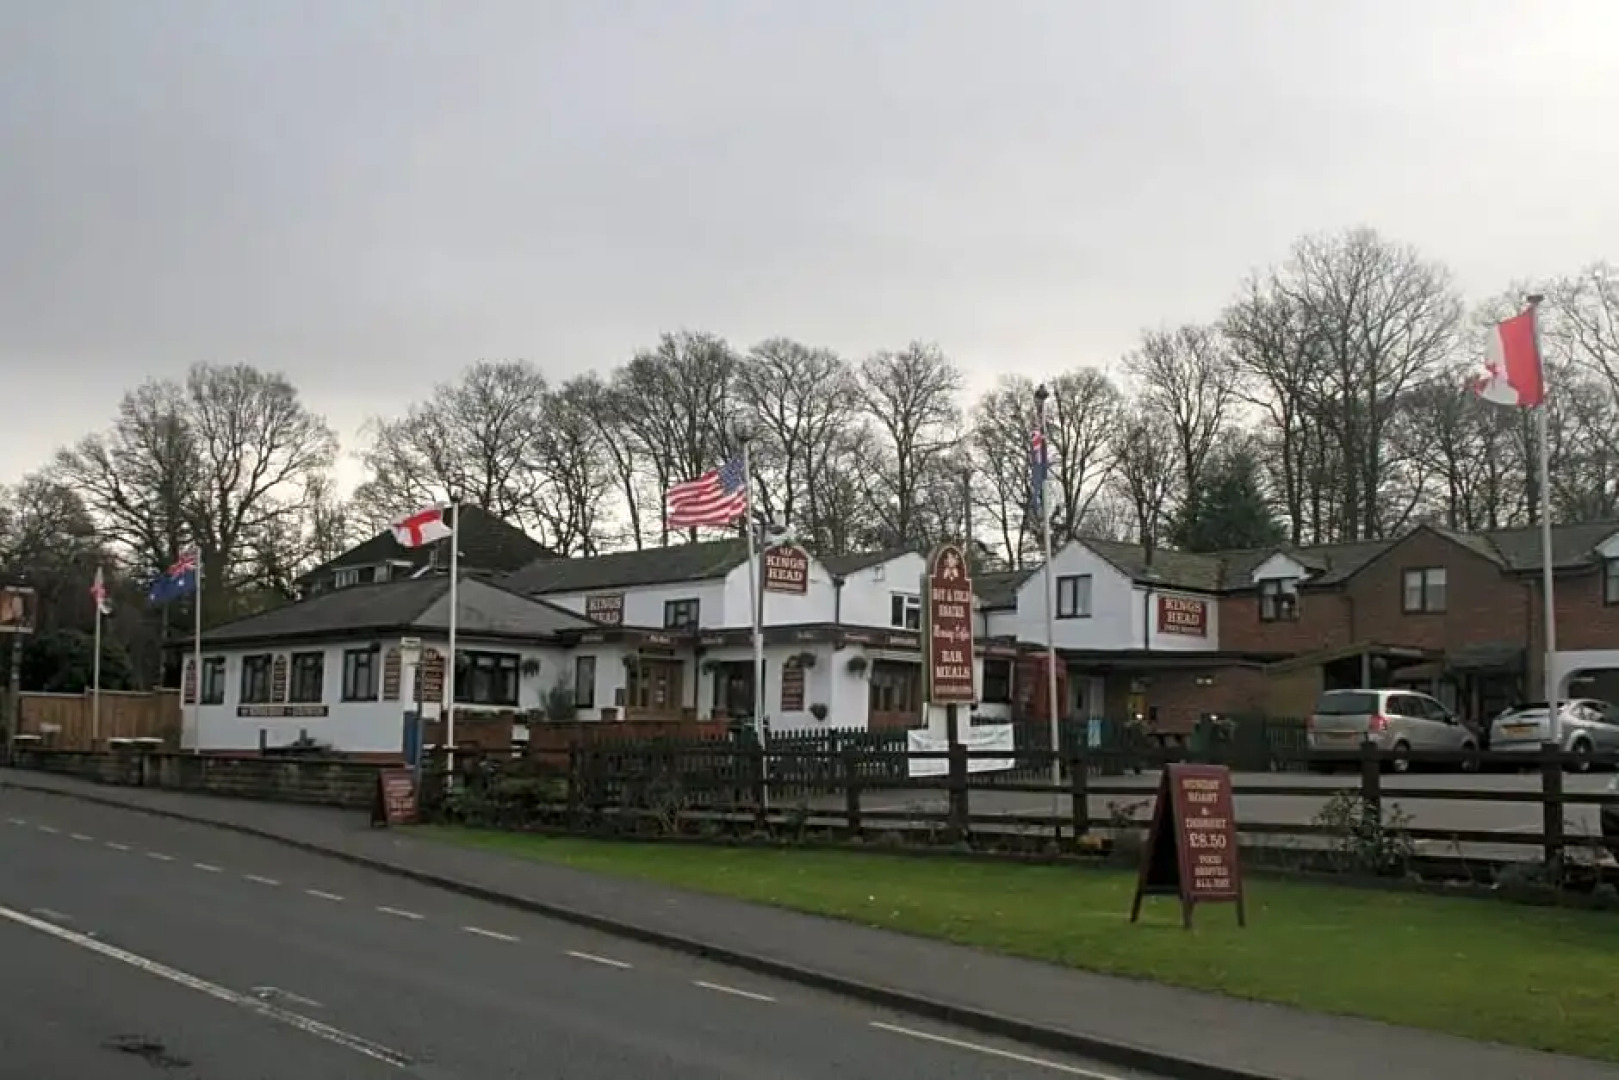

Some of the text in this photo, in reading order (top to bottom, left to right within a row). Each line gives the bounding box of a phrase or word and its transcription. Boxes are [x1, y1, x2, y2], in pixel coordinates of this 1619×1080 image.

[766, 555, 805, 570] KINGS
[767, 568, 803, 581] HEAD
[1164, 598, 1202, 613] KINGS
[1167, 610, 1200, 625] HEAD
[941, 650, 964, 662] BAR
[936, 665, 971, 679] MEALS
